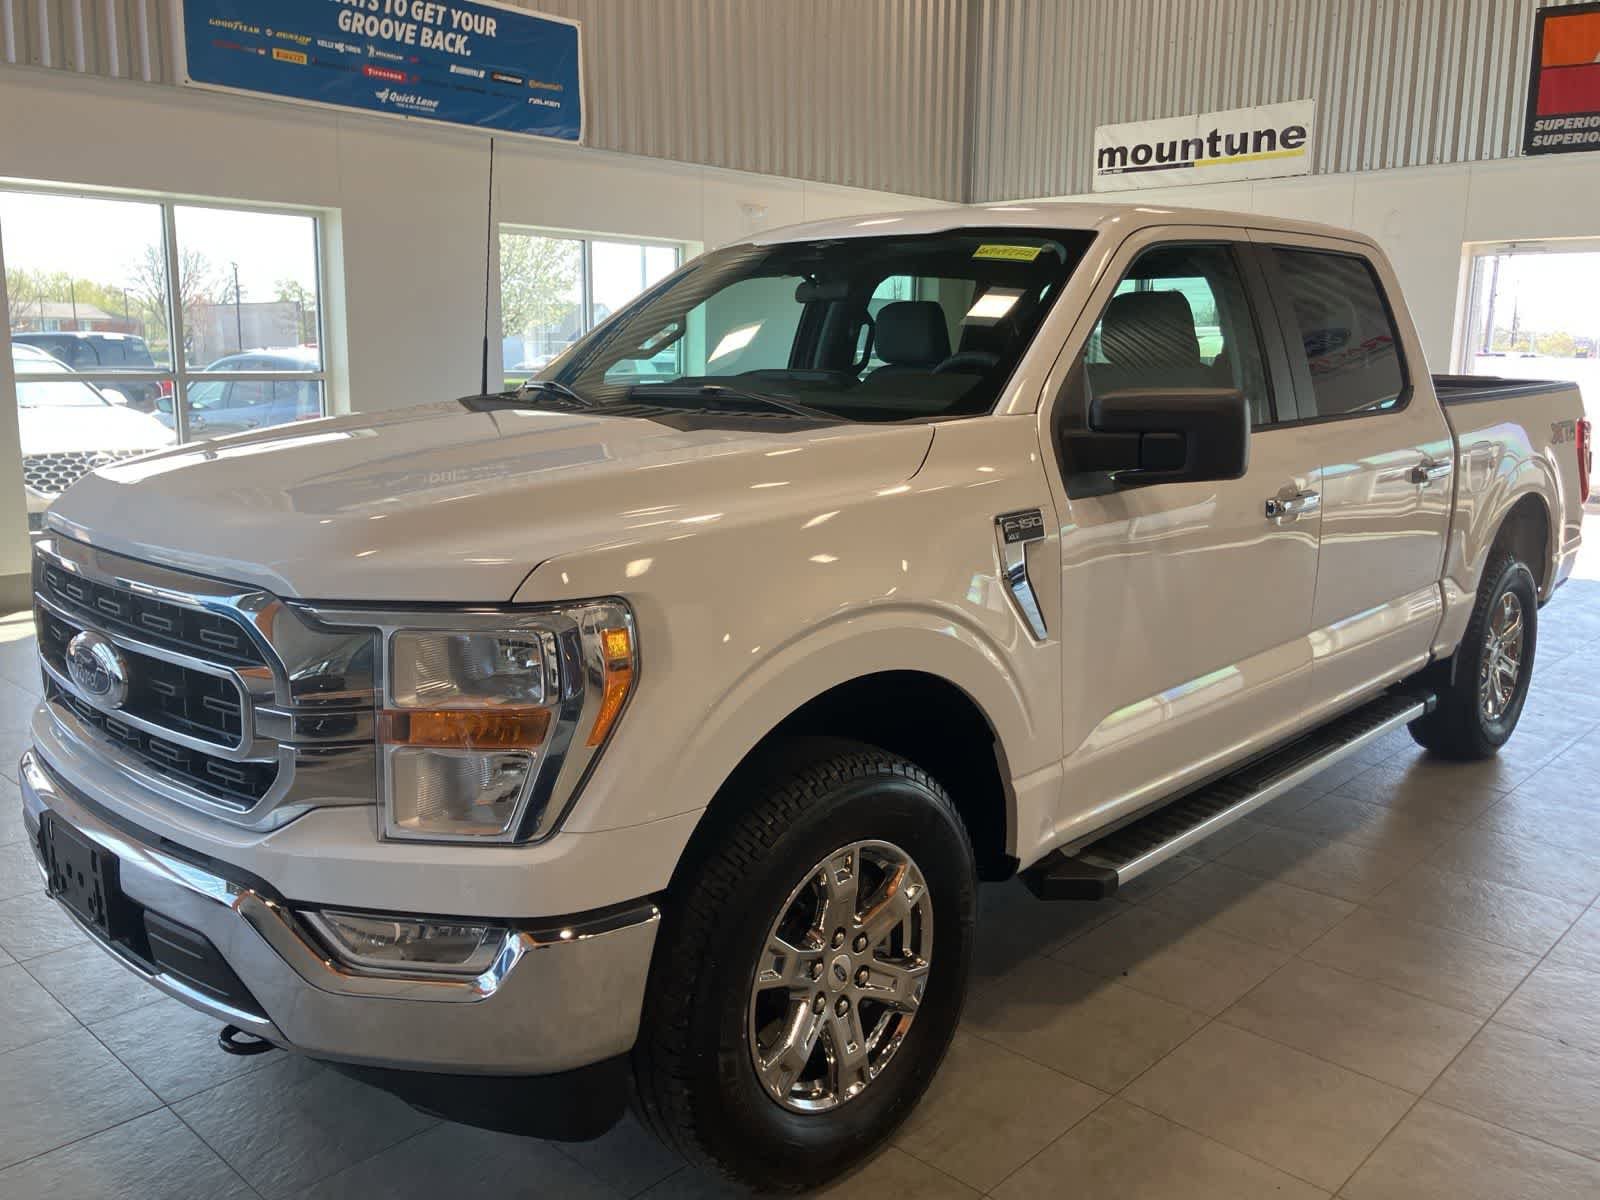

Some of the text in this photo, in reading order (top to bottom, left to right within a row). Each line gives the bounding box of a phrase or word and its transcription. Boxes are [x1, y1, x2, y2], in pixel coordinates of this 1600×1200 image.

[208, 18, 260, 33] GOODYEAR
[384, 0, 408, 17] TO
[411, 0, 447, 25] GET
[451, 8, 497, 37] YOUR
[275, 31, 312, 45] DUNLOP
[338, 9, 471, 56] GROOVE BACK.
[389, 91, 415, 104] Quick
[416, 96, 439, 109] Lane
[1097, 125, 1307, 168] mountune
[1532, 132, 1600, 146] SUPERIO
[1004, 517, 1042, 532] F-150
